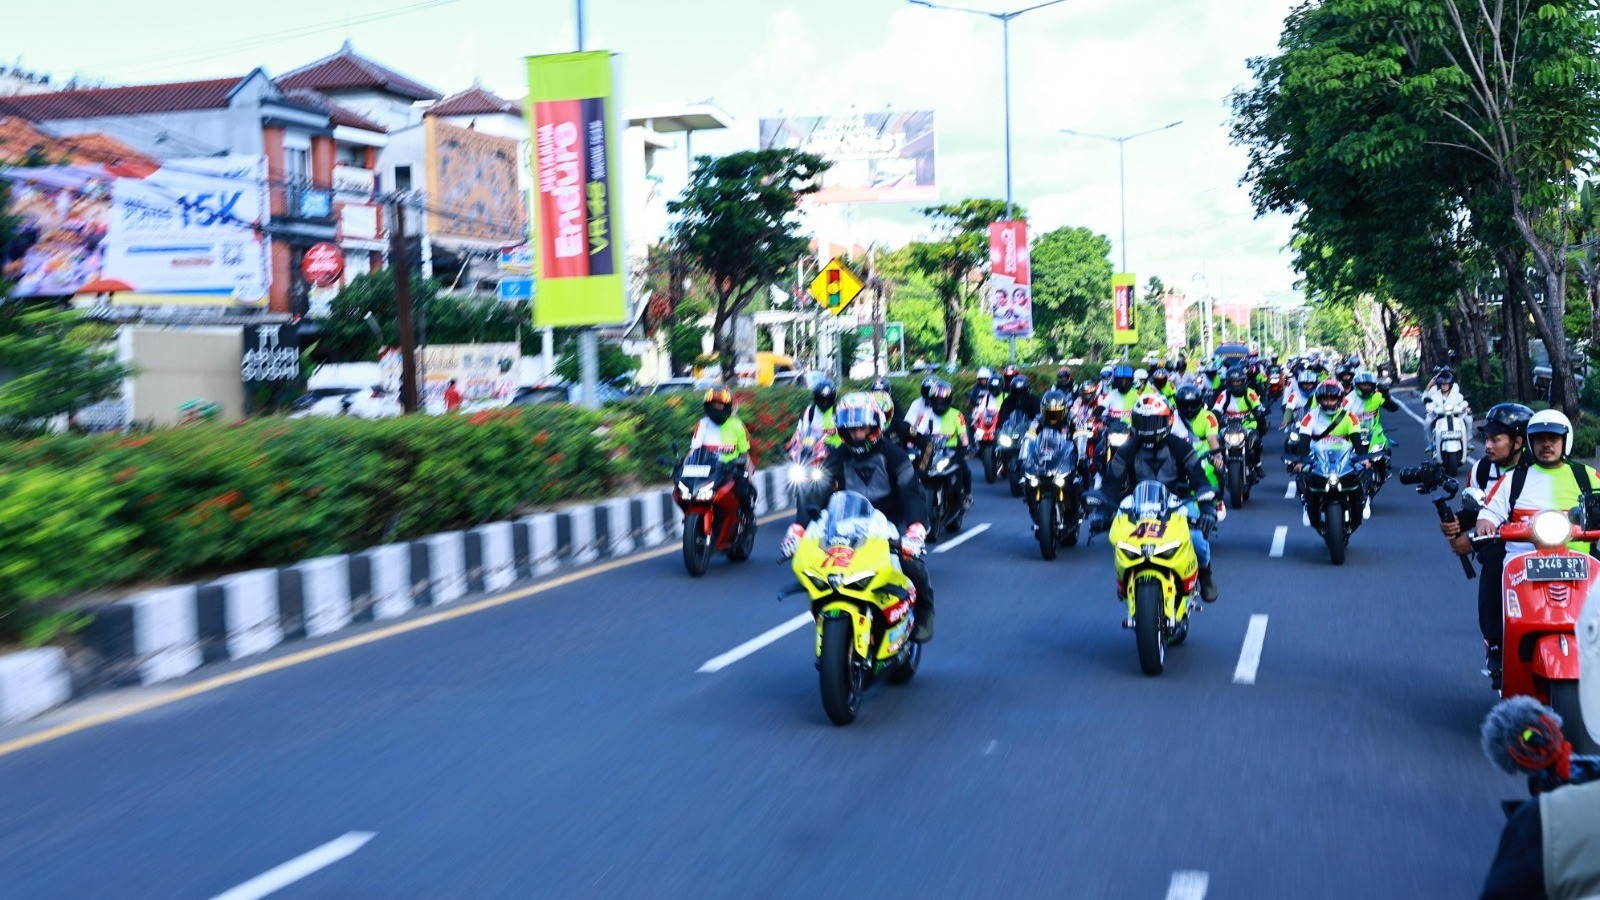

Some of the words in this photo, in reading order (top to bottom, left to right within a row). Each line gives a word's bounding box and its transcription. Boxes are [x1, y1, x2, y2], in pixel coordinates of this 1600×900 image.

[552, 121, 583, 257] Enduro
[821, 546, 855, 568] 72
[1527, 559, 1533, 569] B
[1538, 559, 1562, 569] 3446
[1567, 559, 1585, 569] SPY
